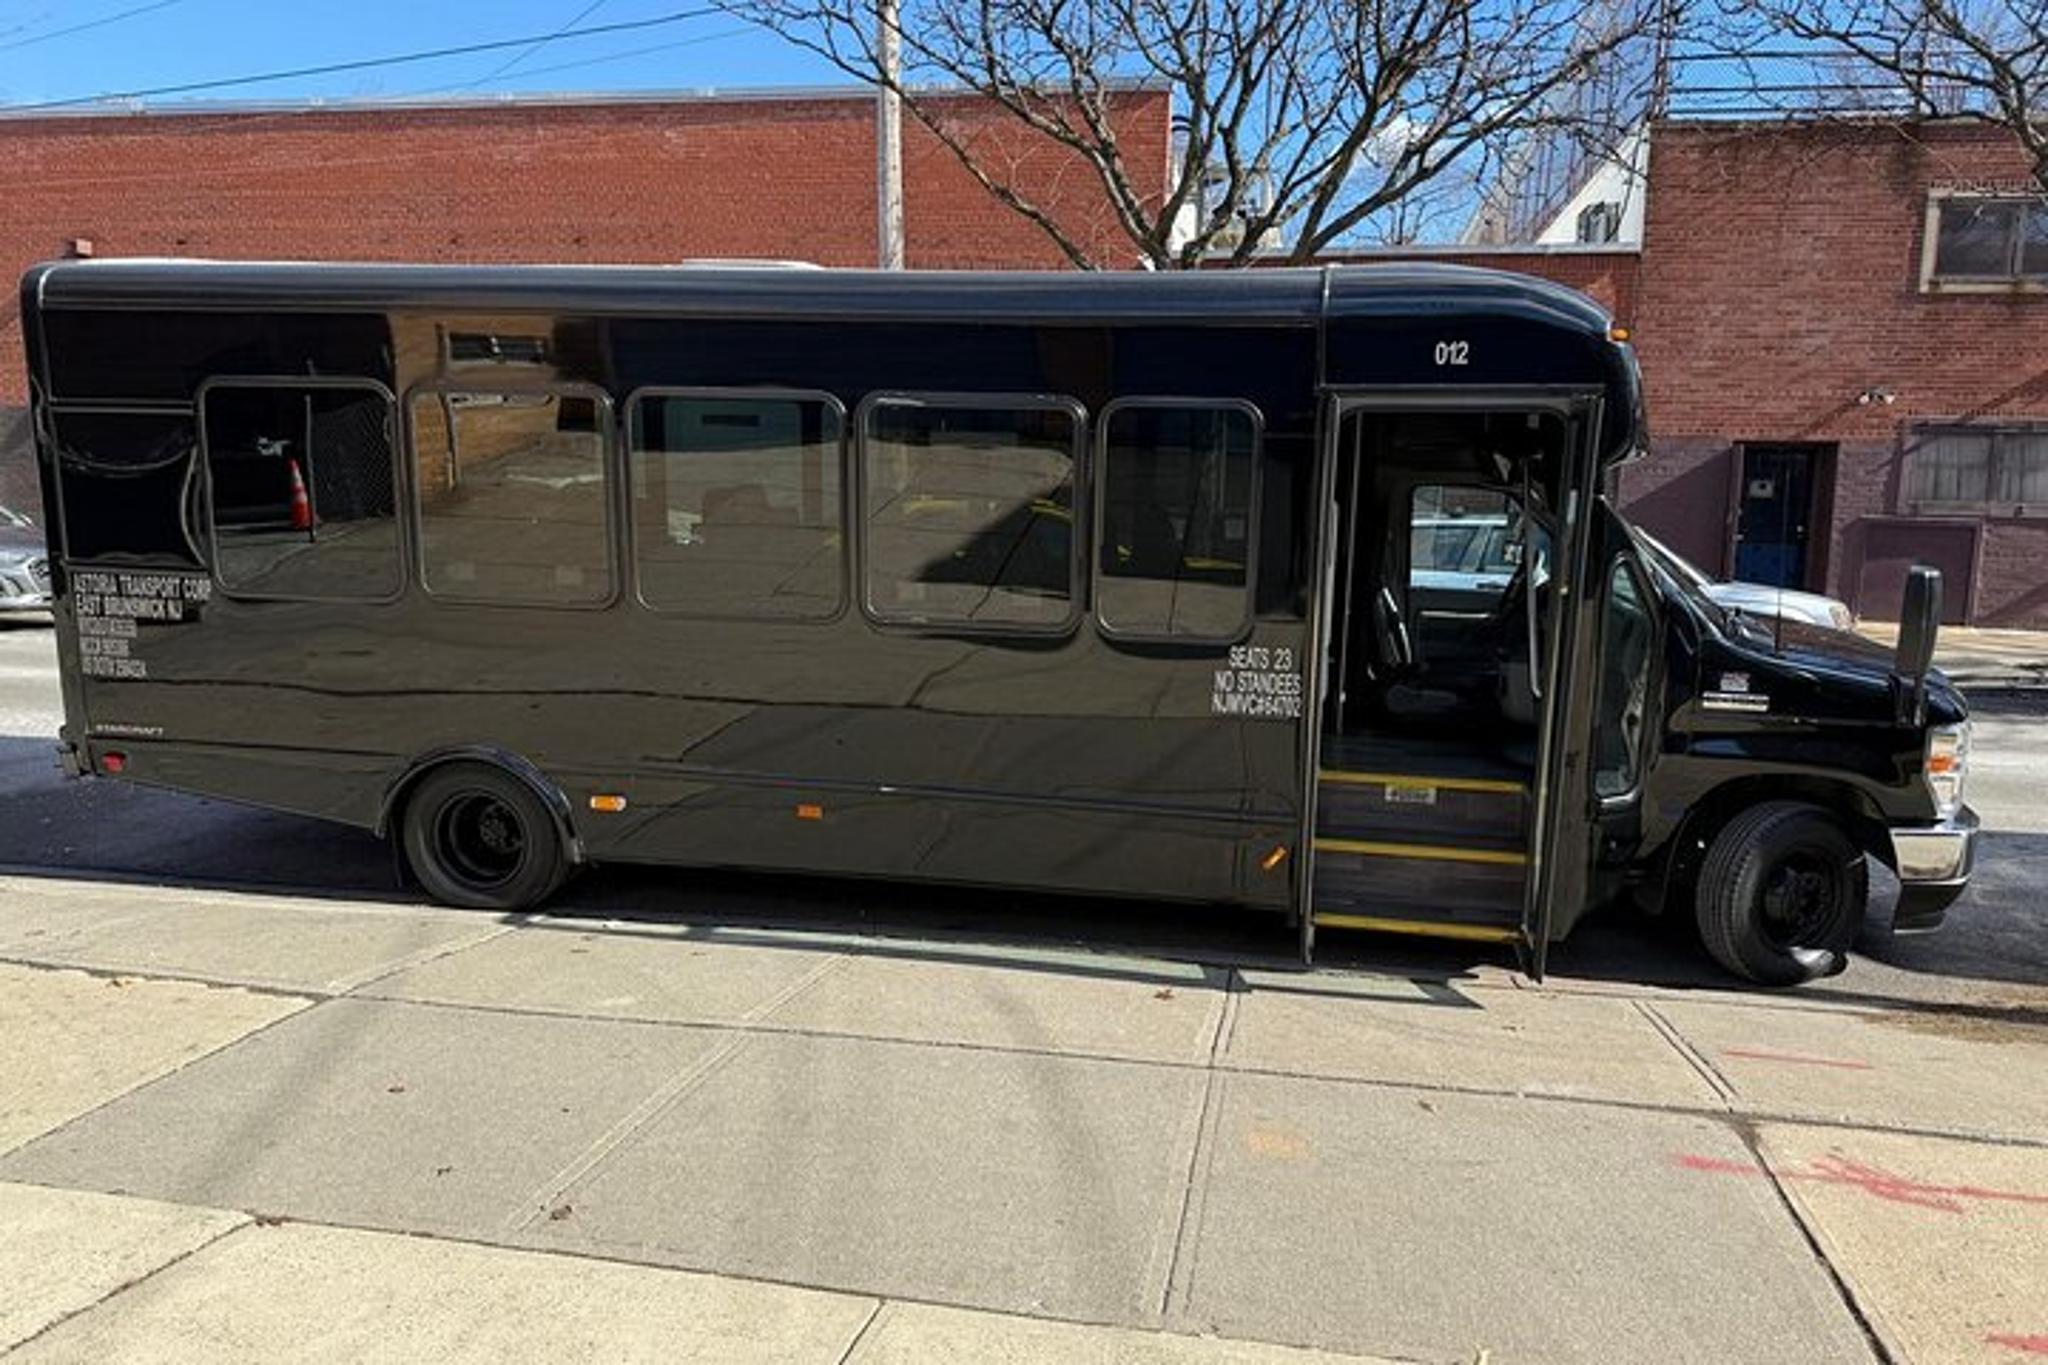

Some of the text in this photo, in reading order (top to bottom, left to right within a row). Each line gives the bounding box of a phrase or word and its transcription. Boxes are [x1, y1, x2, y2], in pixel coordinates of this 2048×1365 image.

[1436, 341, 1469, 365] 012
[119, 575, 180, 598] TRANSPORT
[183, 579, 212, 601] CORP
[76, 593, 183, 620] EAST BRUNSWICK NJ
[1229, 646, 1293, 671] SEATS 23
[1214, 670, 1301, 695] NO STANDEES
